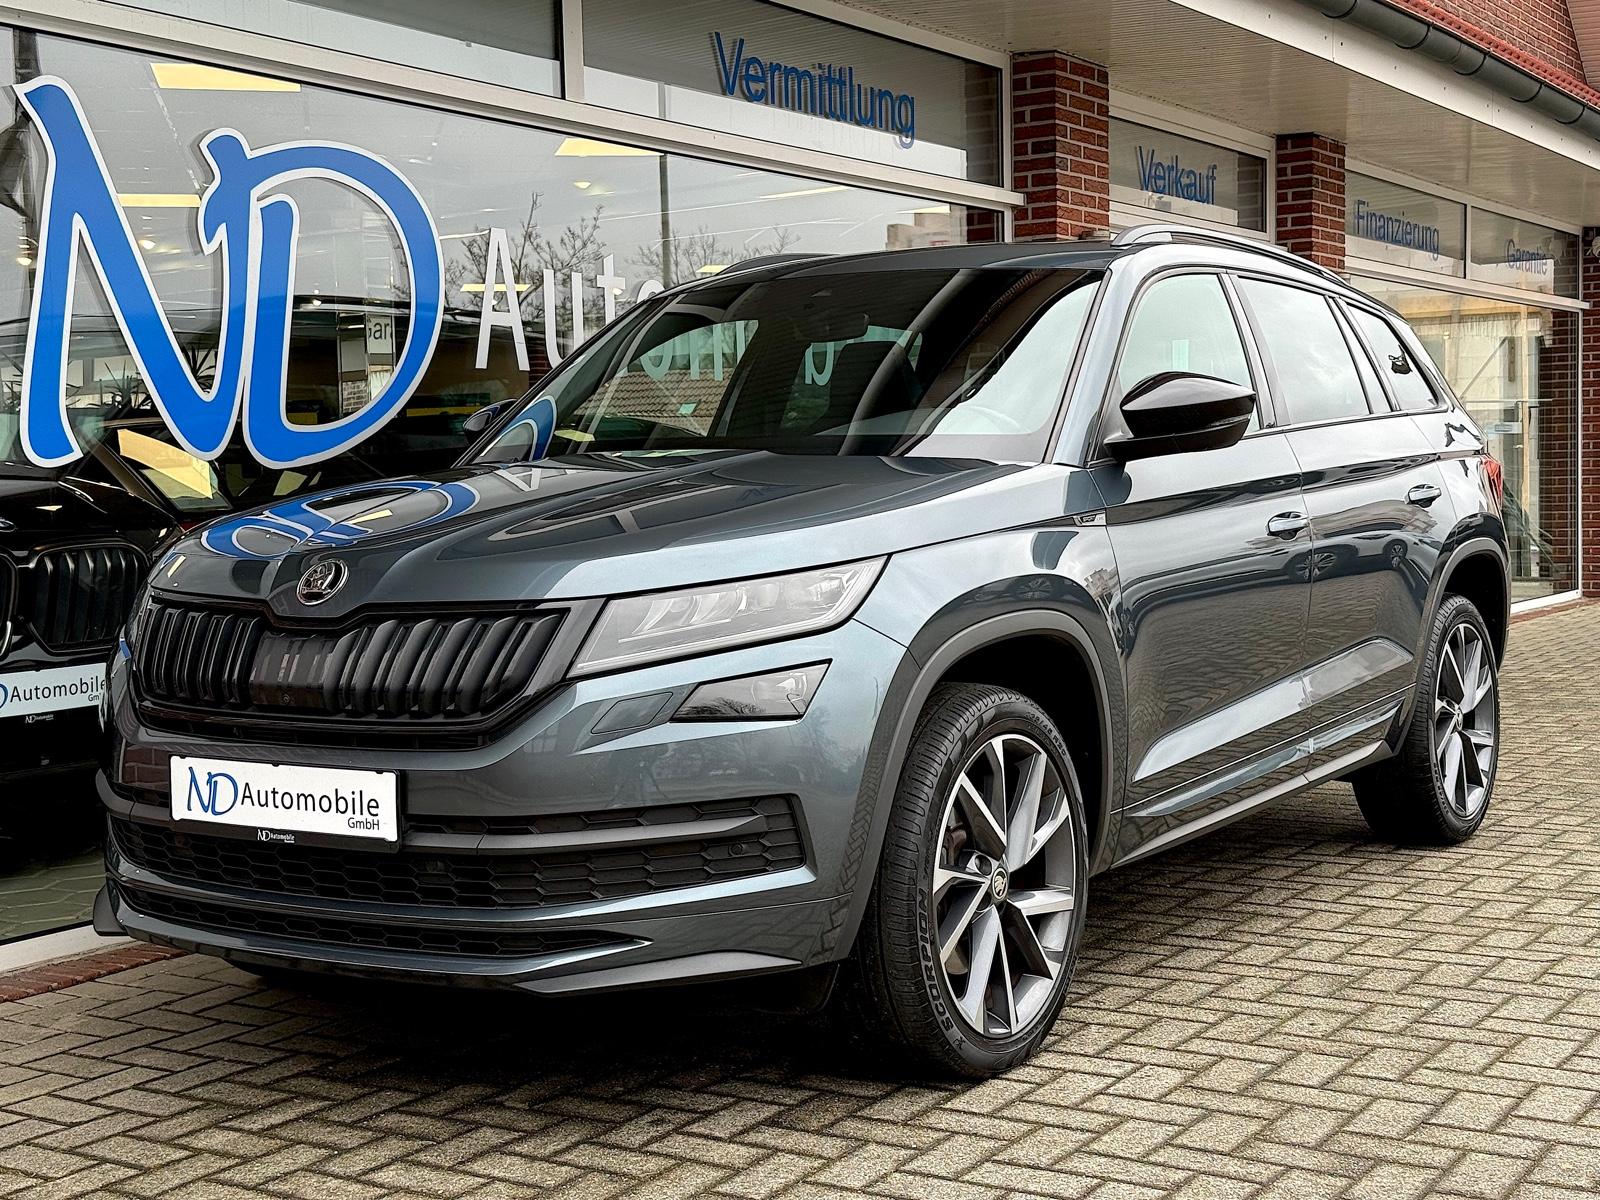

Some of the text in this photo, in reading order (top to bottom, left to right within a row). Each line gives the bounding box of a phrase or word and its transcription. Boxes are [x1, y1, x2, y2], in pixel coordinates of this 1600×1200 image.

[713, 31, 915, 149] Vermittlung
[1137, 145, 1218, 205] Verkauf
[1355, 199, 1440, 261] Finanzierung
[1505, 238, 1548, 275] Garantie
[12, 75, 444, 469] ND
[186, 766, 380, 817] ND Automobile
[257, 828, 271, 842] ND
[347, 817, 380, 831] GmbH
[918, 887, 955, 1033] SCORPION
